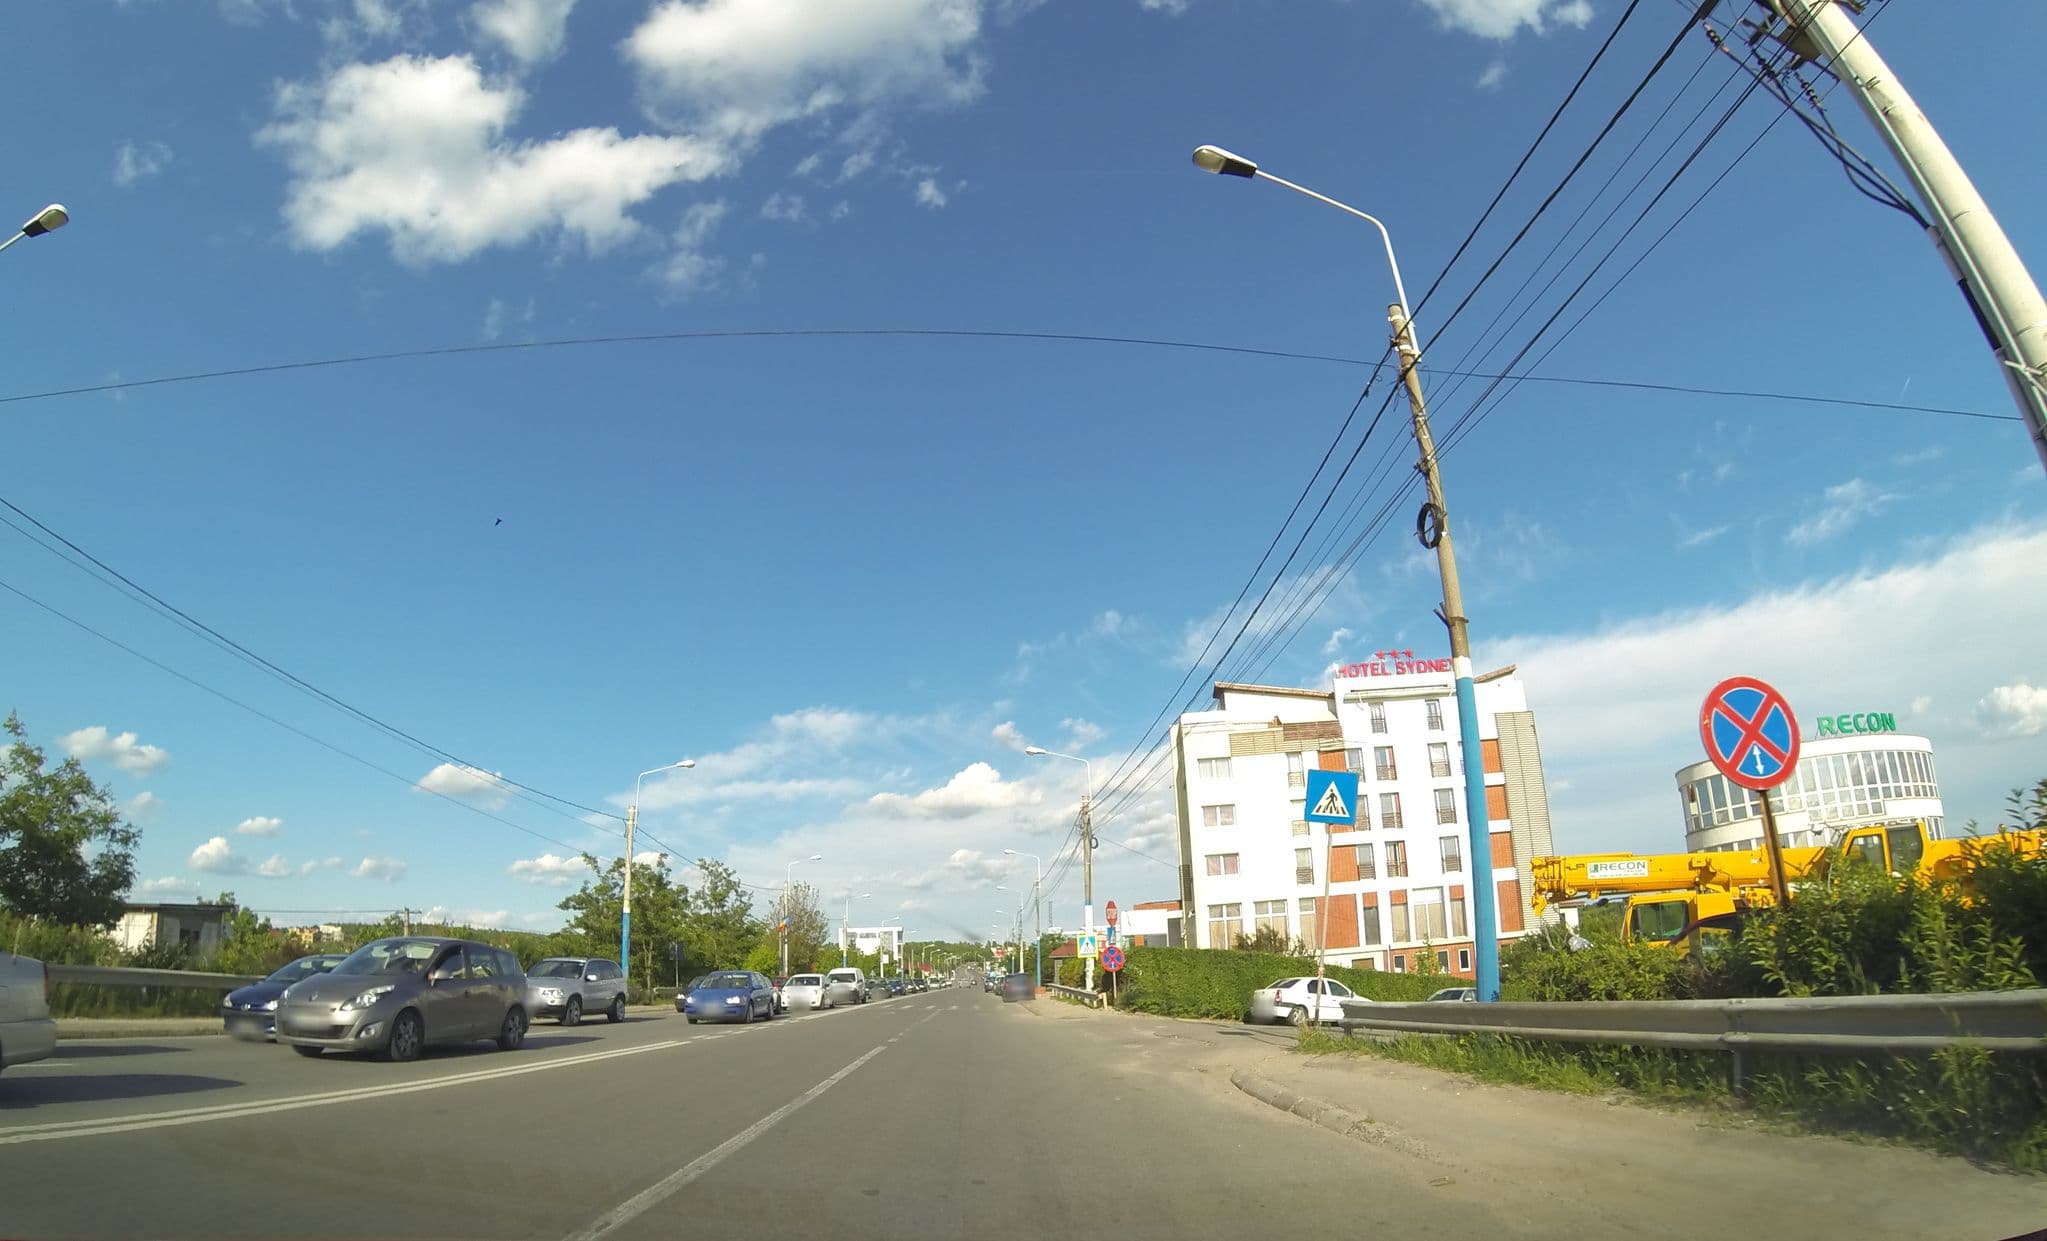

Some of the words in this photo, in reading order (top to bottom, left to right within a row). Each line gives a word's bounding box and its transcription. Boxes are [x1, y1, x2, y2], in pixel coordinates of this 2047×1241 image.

[1336, 661, 1391, 678] HOTEL
[1817, 713, 1896, 736] RECON
[1599, 861, 1646, 871] RECON
